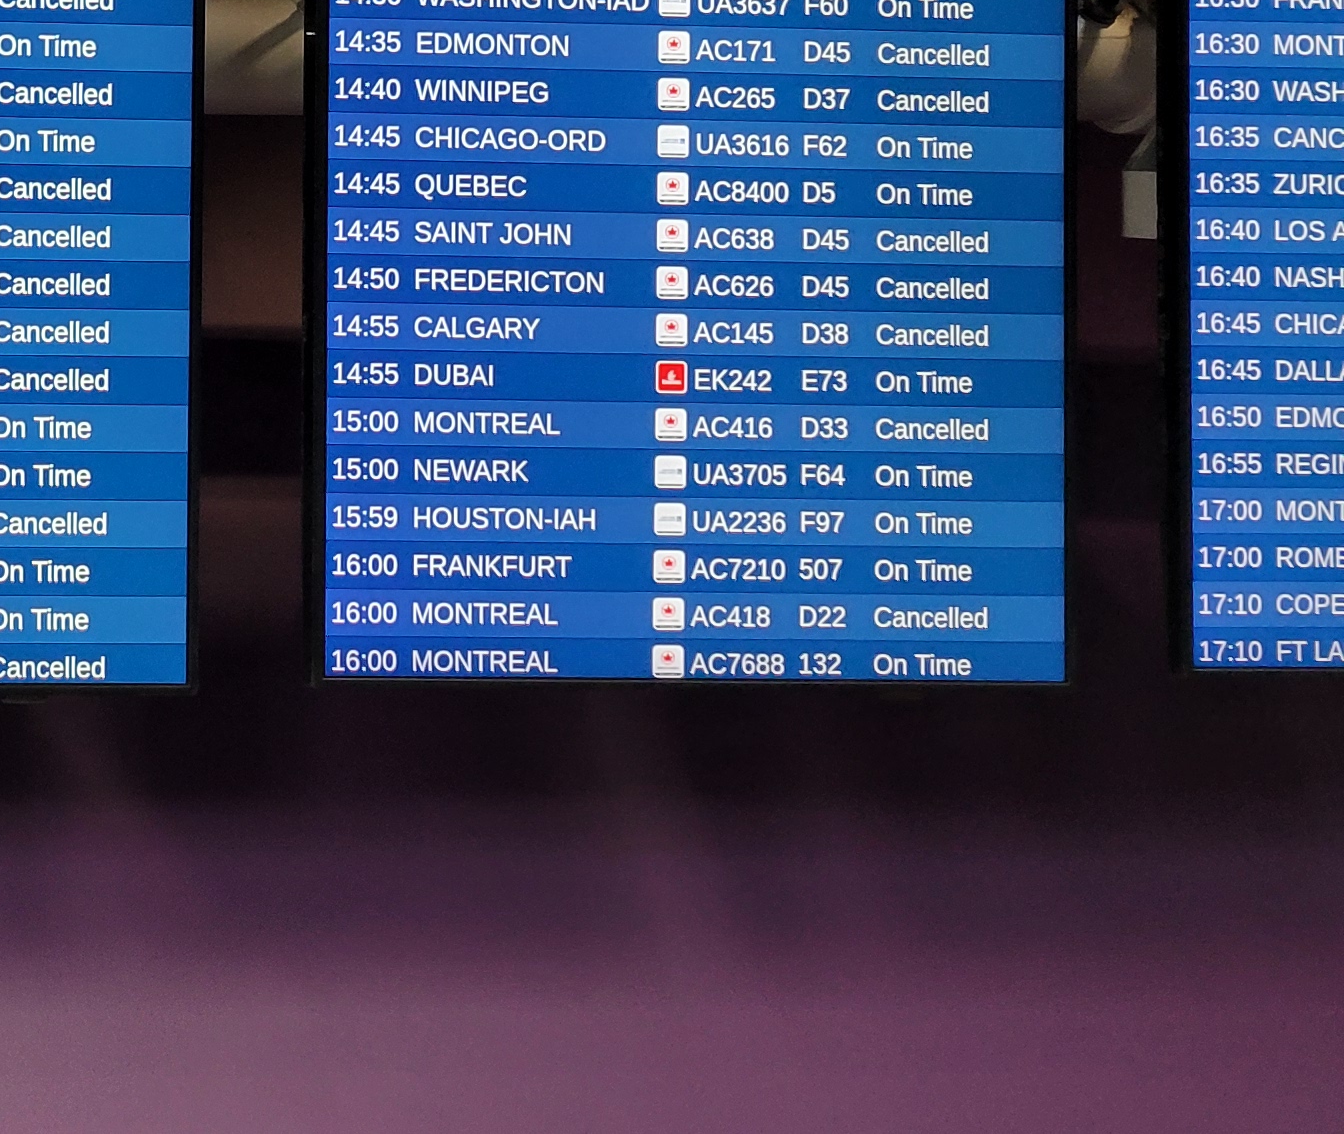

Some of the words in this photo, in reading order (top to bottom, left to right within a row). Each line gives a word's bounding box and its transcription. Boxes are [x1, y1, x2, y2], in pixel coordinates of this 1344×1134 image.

[336, 30, 401, 52] 14:35
[417, 32, 568, 56] EDMONTON
[696, 40, 775, 62] AC171
[805, 41, 850, 62] D45
[878, 43, 989, 66] Cancelled
[1196, 219, 1260, 240] 16:40
[1275, 220, 1325, 241] LOS
[334, 363, 398, 384] 14:55
[415, 364, 493, 386] DUBAI
[695, 369, 771, 391] EK242
[802, 370, 847, 391] E73
[876, 371, 910, 392] On
[918, 371, 972, 393] Time
[332, 650, 396, 671] 16:00
[413, 650, 558, 672] MONTREAL
[690, 653, 784, 675] AC7688
[799, 653, 841, 675] 132
[874, 654, 907, 675] On
[915, 654, 971, 675] Time
